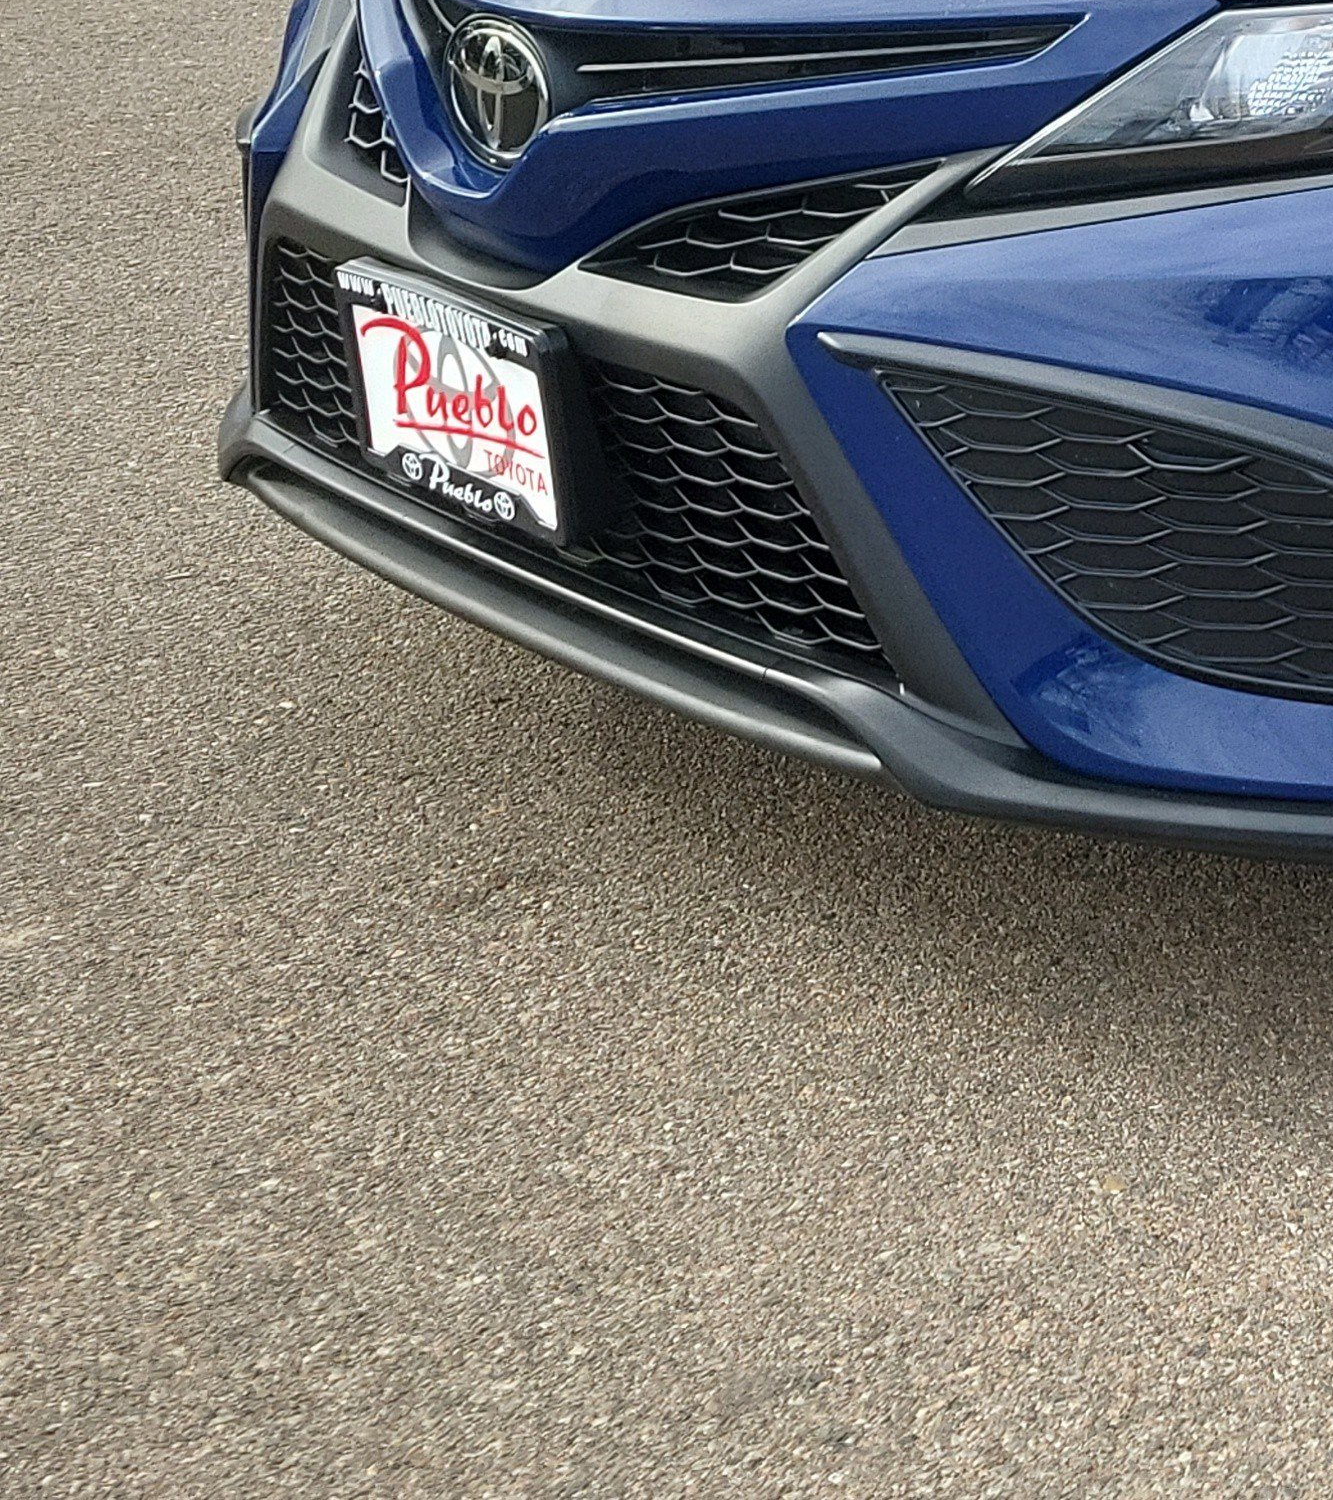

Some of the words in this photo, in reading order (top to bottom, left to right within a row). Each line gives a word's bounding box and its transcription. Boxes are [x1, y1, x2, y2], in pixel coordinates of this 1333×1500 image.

[360, 317, 537, 436] Pueblo
[419, 451, 493, 512] Pueblo
[484, 450, 548, 496] TOYOTA
